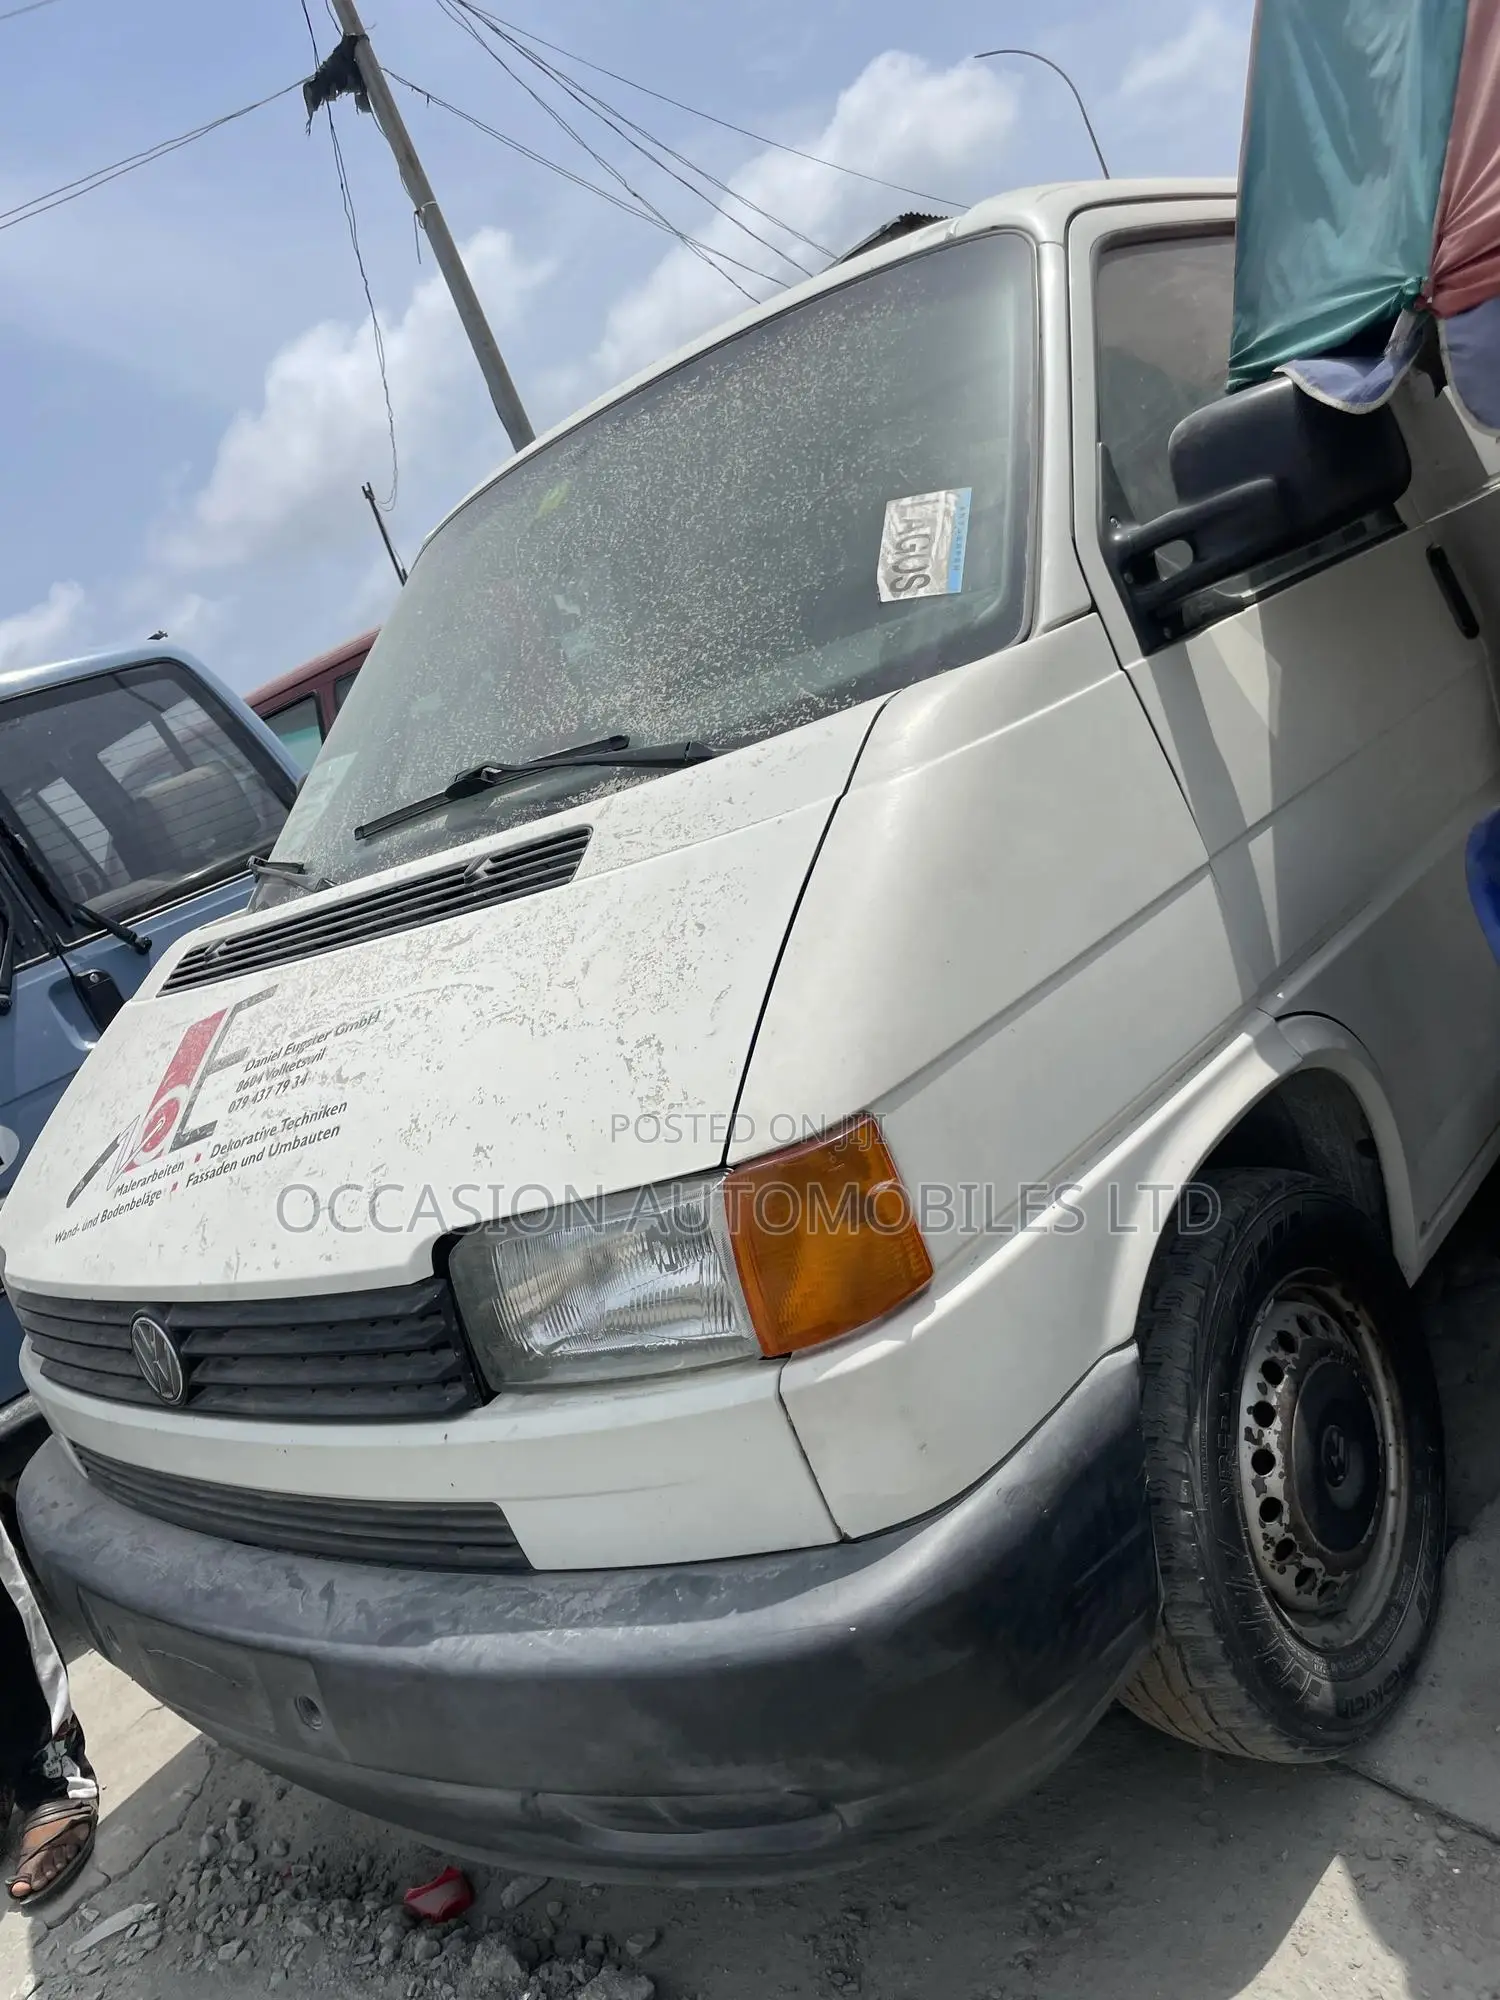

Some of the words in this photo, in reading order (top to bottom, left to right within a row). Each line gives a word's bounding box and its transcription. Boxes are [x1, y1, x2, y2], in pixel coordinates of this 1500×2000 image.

[889, 499, 939, 593] LAGOS
[244, 1048, 282, 1073] Daniel
[283, 1030, 333, 1057] Eugster
[334, 1010, 382, 1037] GmbH
[228, 1095, 249, 1114] 079
[251, 1086, 274, 1105] 437
[275, 1079, 291, 1096] 79
[291, 1072, 310, 1090] 34
[235, 1073, 264, 1093] 8604
[81, 1213, 101, 1233] und
[100, 1188, 163, 1224] Bodenbeläge
[185, 1158, 238, 1189] Fassaden
[241, 1148, 265, 1169] und
[268, 1124, 340, 1157] Umbauten
[113, 1160, 184, 1199] Malerarbeiten
[210, 1126, 277, 1159] Dekorative
[281, 1100, 348, 1132] Techniken
